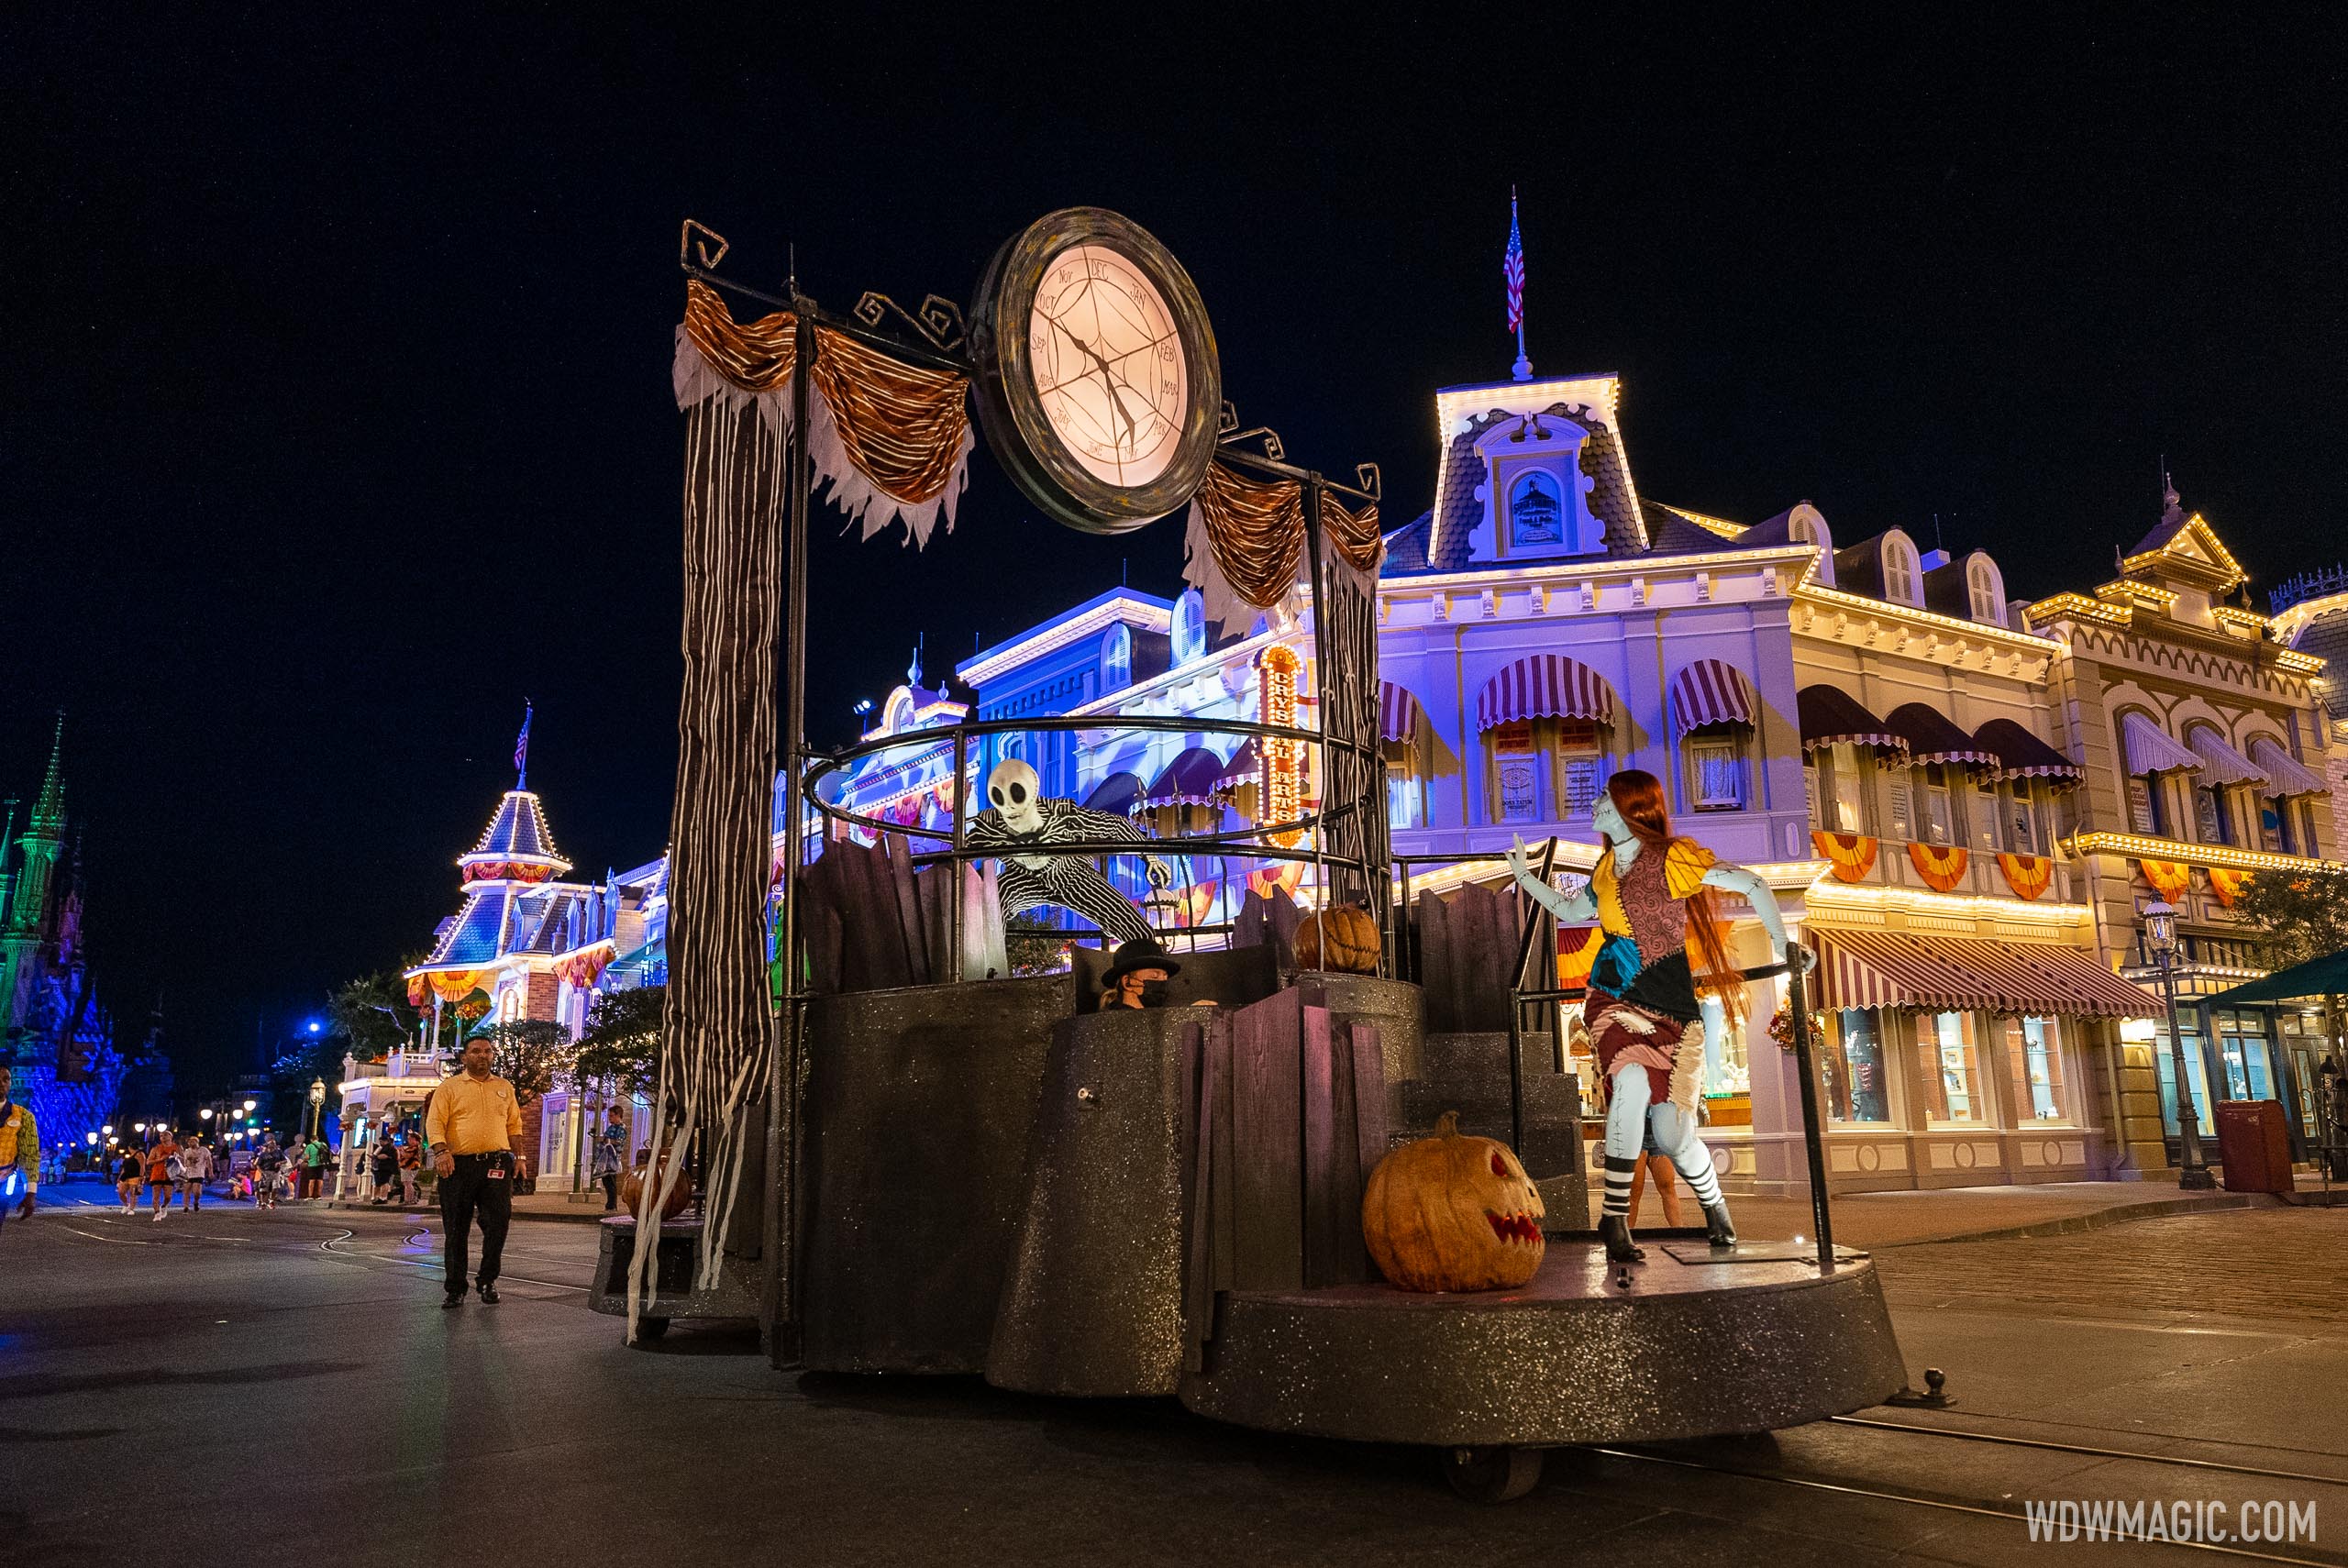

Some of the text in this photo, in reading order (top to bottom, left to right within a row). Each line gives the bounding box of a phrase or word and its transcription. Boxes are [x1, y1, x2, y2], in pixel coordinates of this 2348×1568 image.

[1091, 259, 1109, 281] DEC
[1039, 293, 1056, 310] OCT
[1130, 282, 1146, 311] JAN
[1031, 333, 1047, 353] SEP
[1160, 342, 1175, 362] FEB
[1037, 372, 1053, 387] AUG
[1162, 379, 1179, 396] MAR
[1153, 421, 1167, 436] APR
[1086, 440, 1103, 457] JUNE
[1276, 771, 1291, 823] ARTS
